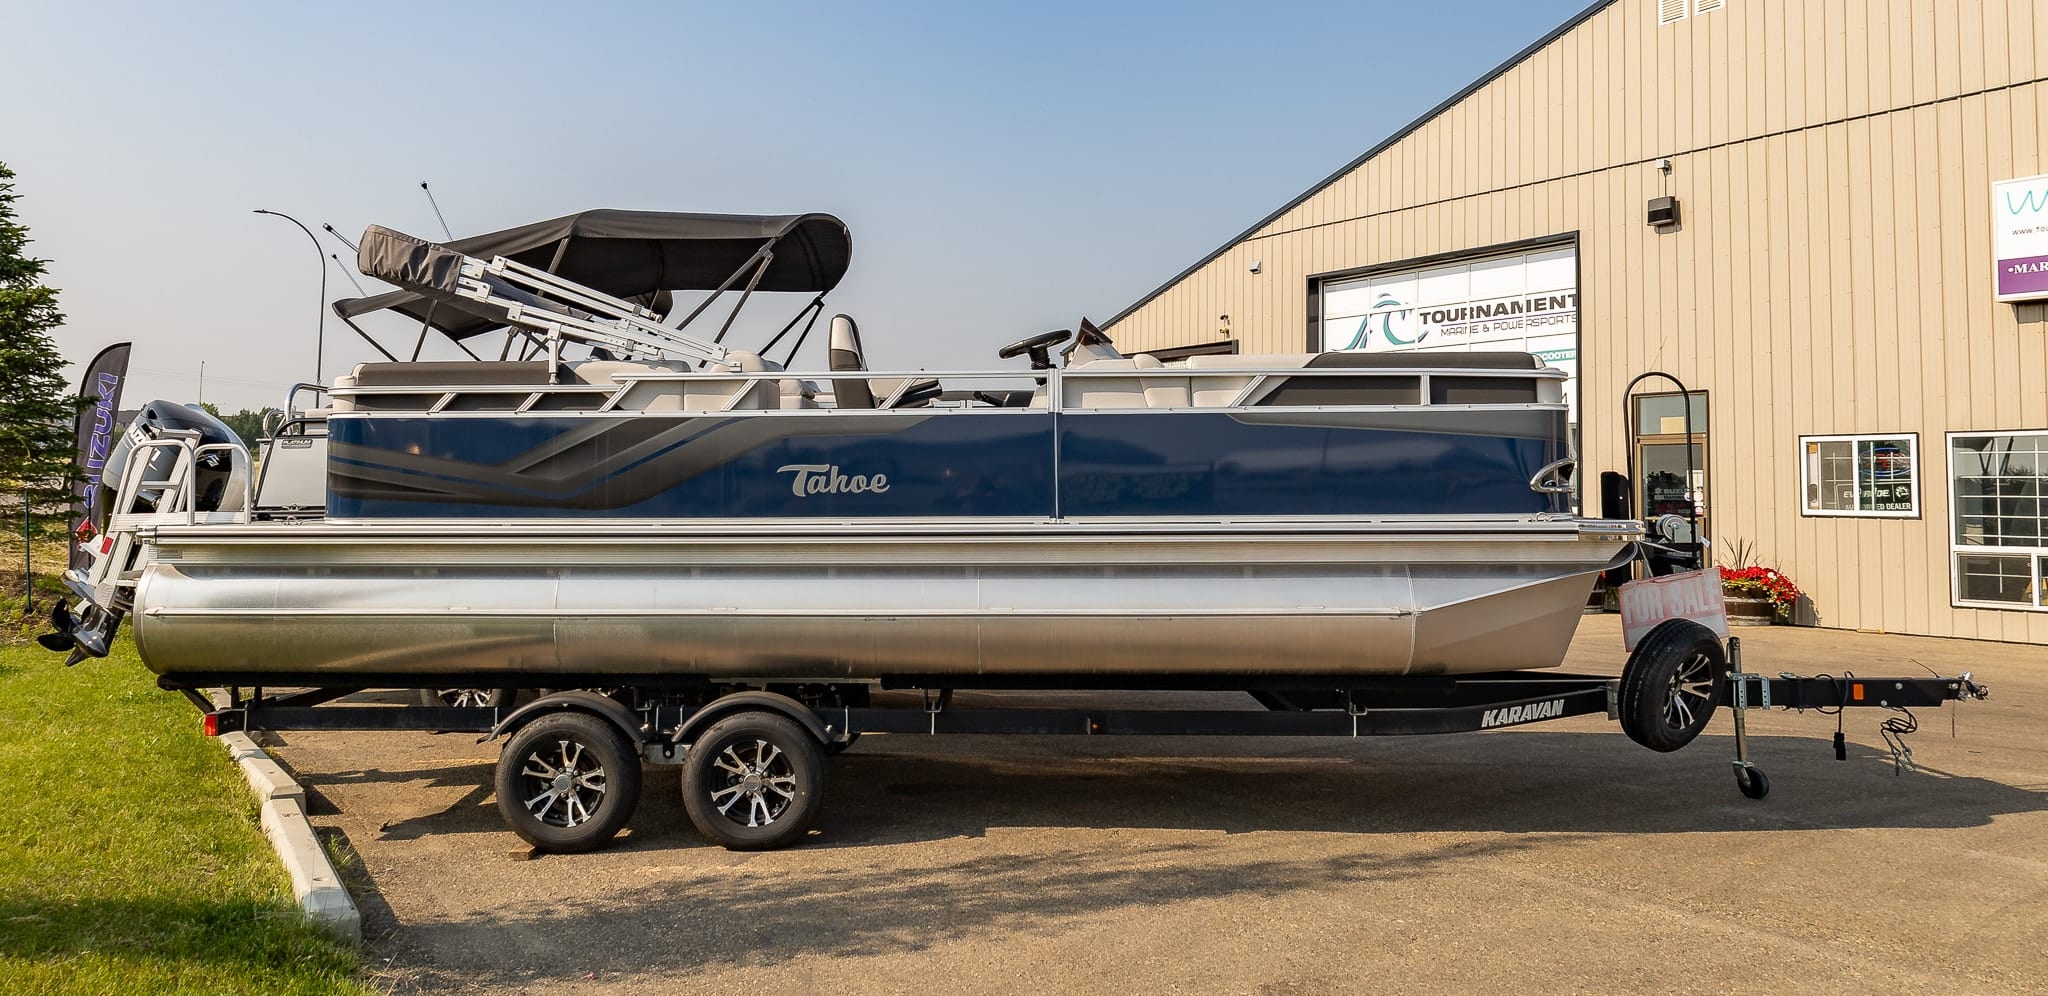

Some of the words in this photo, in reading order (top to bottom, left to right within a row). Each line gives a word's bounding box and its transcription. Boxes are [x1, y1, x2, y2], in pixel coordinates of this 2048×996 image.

[1420, 294, 1576, 325] TOURNAMENT
[1440, 325, 1479, 336] MARINE
[1482, 324, 1490, 332] &
[776, 464, 890, 497] Tahoe
[1624, 586, 1664, 624] FOR
[1670, 577, 1720, 616] SALE
[1481, 699, 1565, 728] KARAVAN
